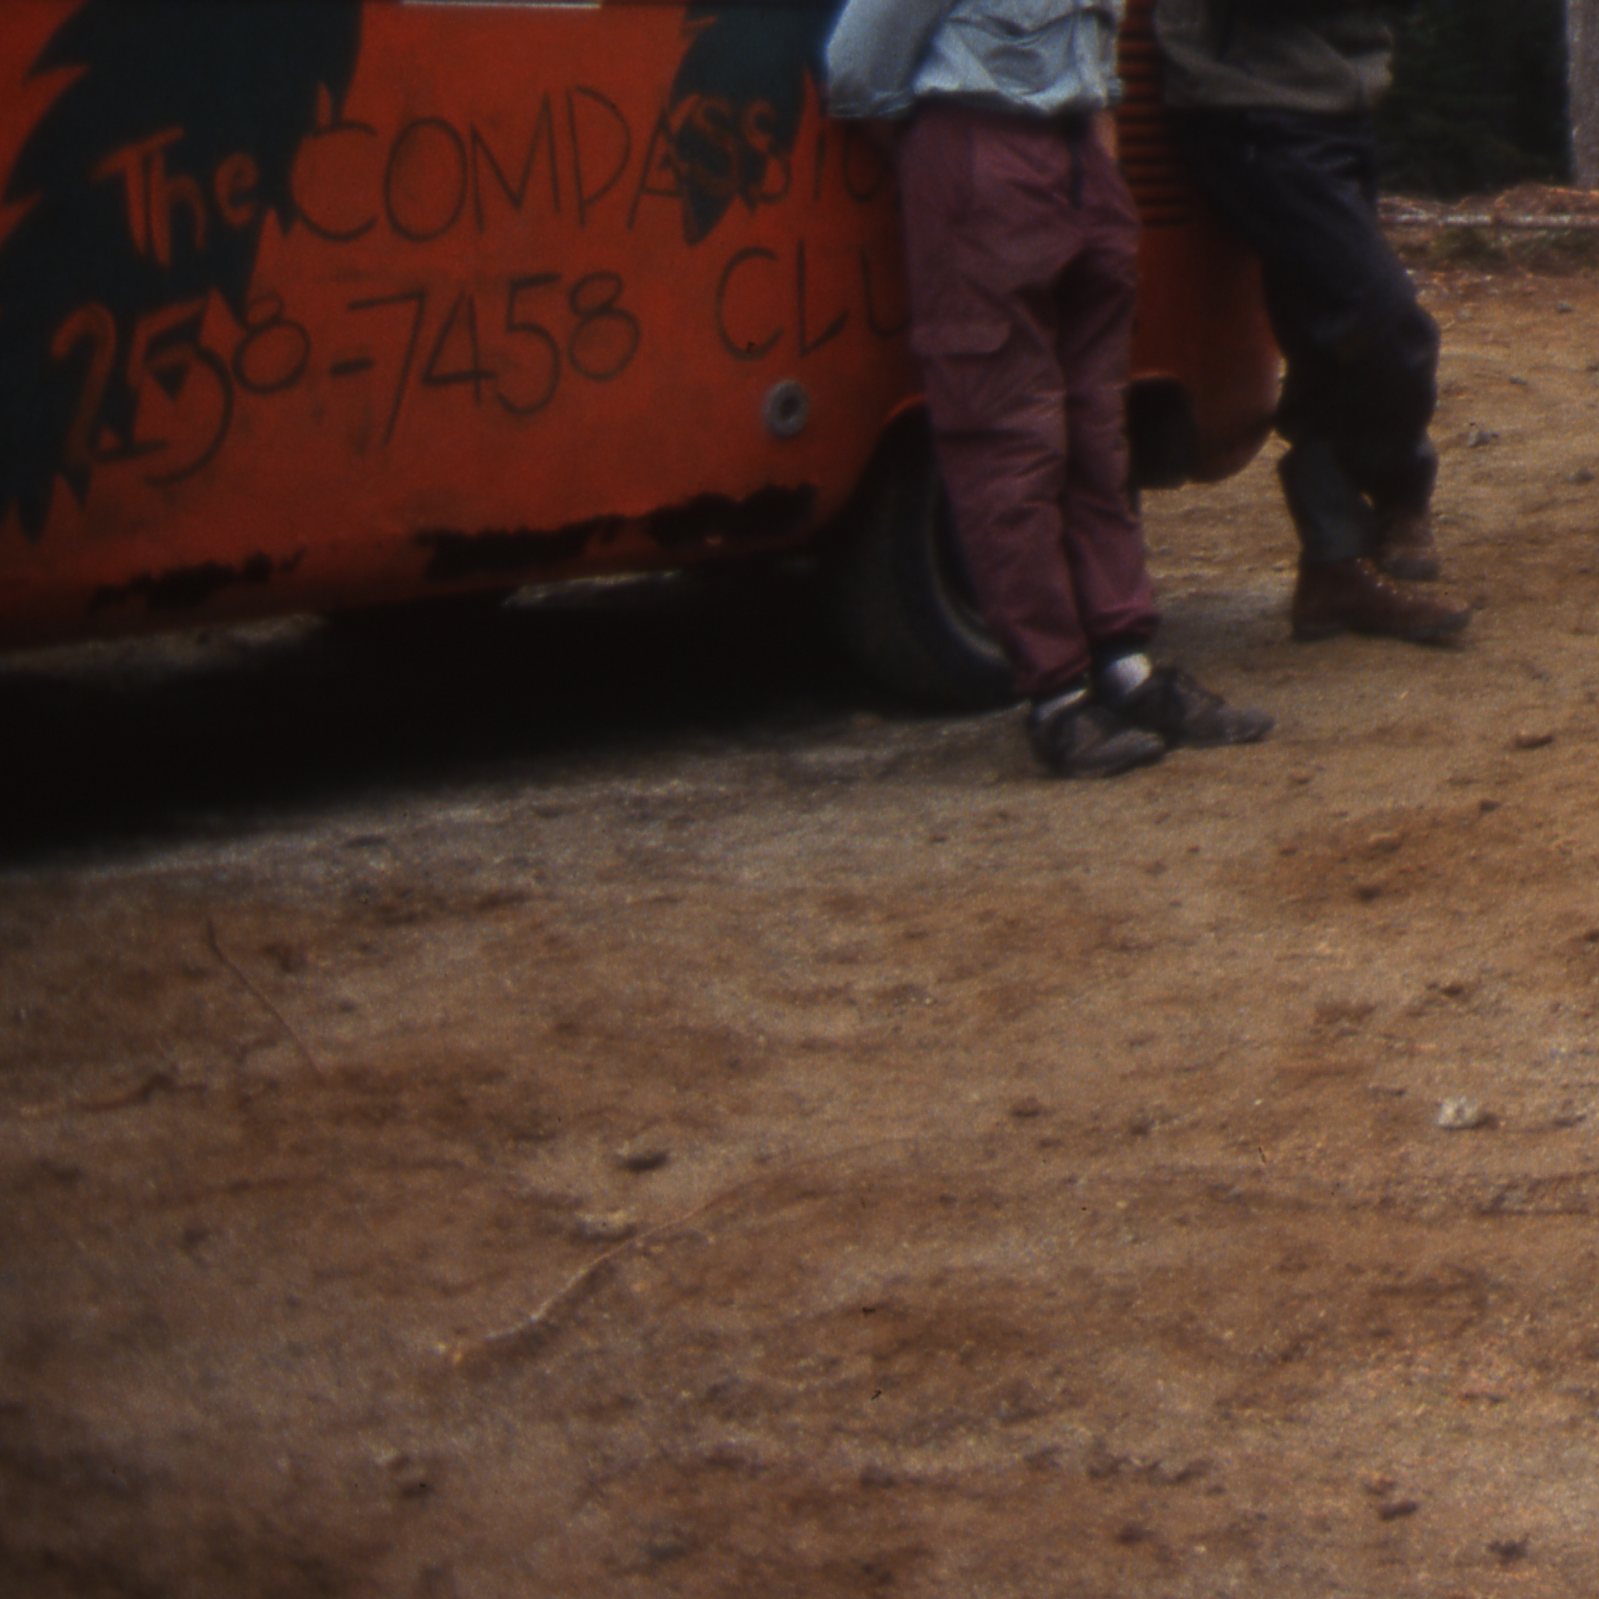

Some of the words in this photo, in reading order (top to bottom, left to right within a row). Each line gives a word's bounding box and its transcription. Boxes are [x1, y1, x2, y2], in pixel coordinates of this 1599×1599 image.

[91, 125, 262, 268] The
[289, 85, 888, 242] COMPASSIO
[48, 271, 641, 486] 258-7458
[715, 239, 912, 362] CLU
